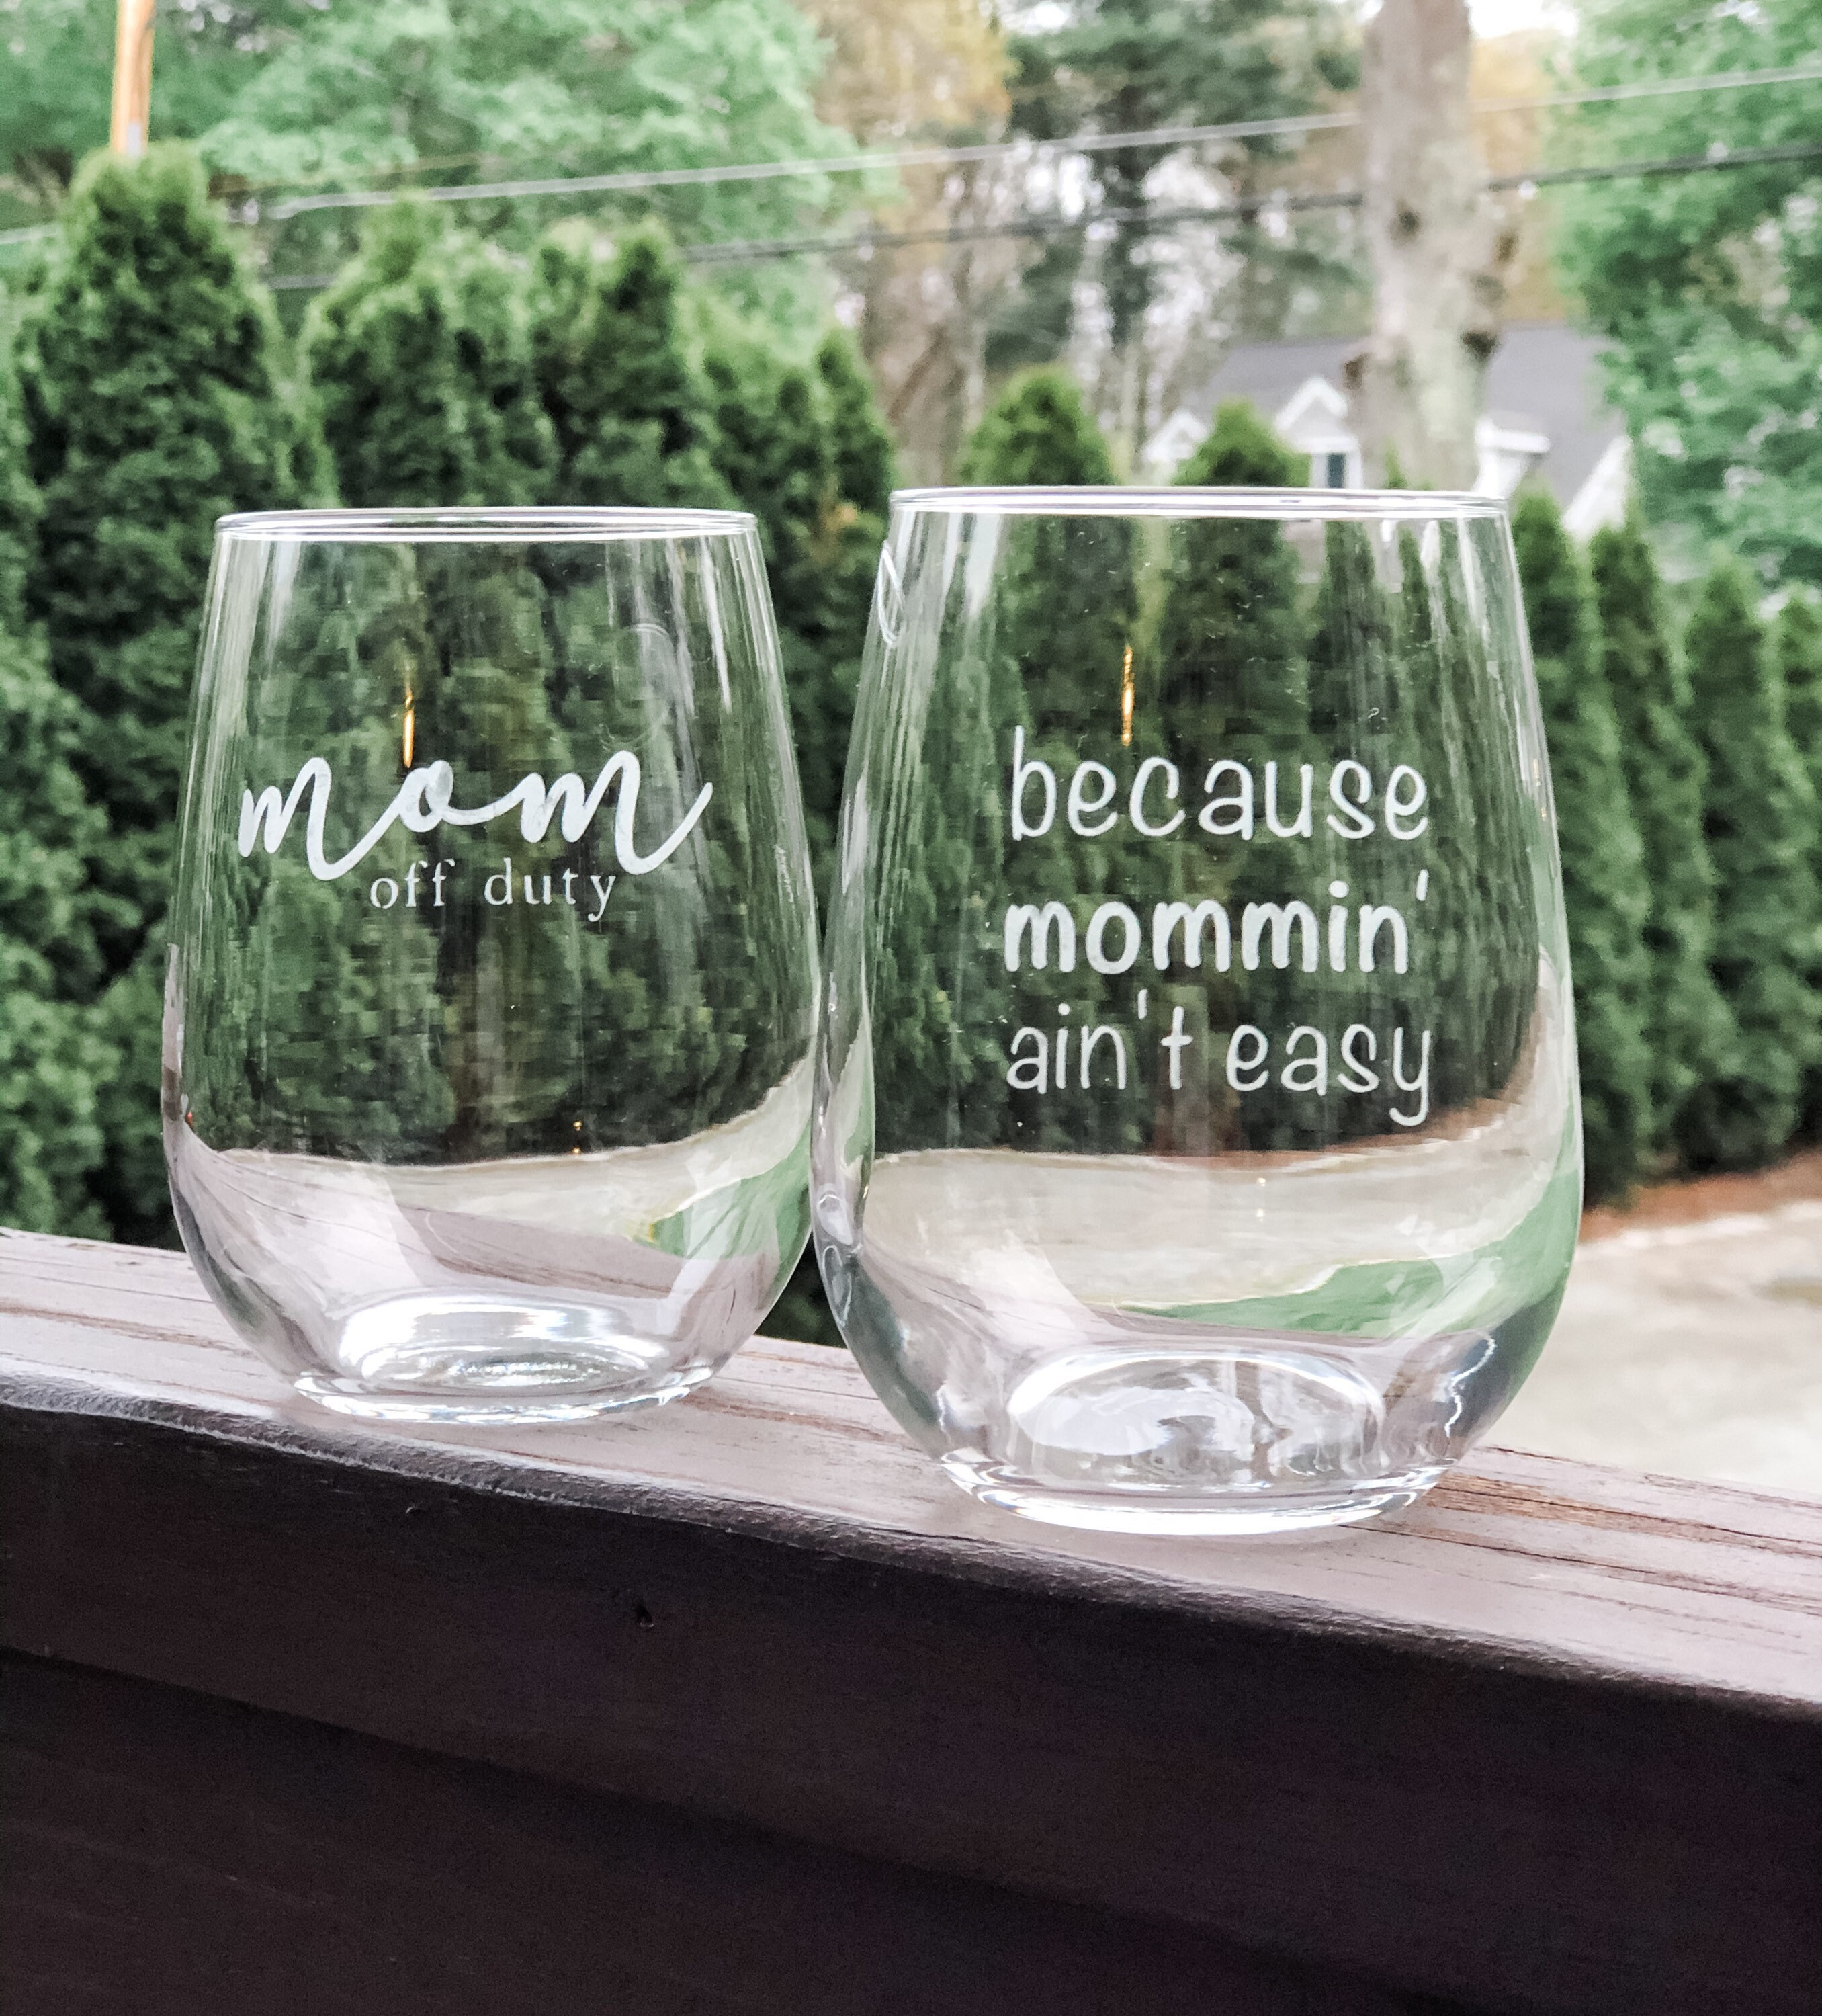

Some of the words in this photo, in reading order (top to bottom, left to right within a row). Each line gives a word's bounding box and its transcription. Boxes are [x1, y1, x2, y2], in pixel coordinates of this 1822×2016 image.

[238, 751, 713, 880] mom
[1010, 725, 1428, 841] because
[370, 858, 455, 908] off
[484, 857, 616, 922] duty
[1004, 870, 1429, 974] mommin'
[1006, 989, 1193, 1094] ain't
[1226, 1023, 1430, 1126] easy
